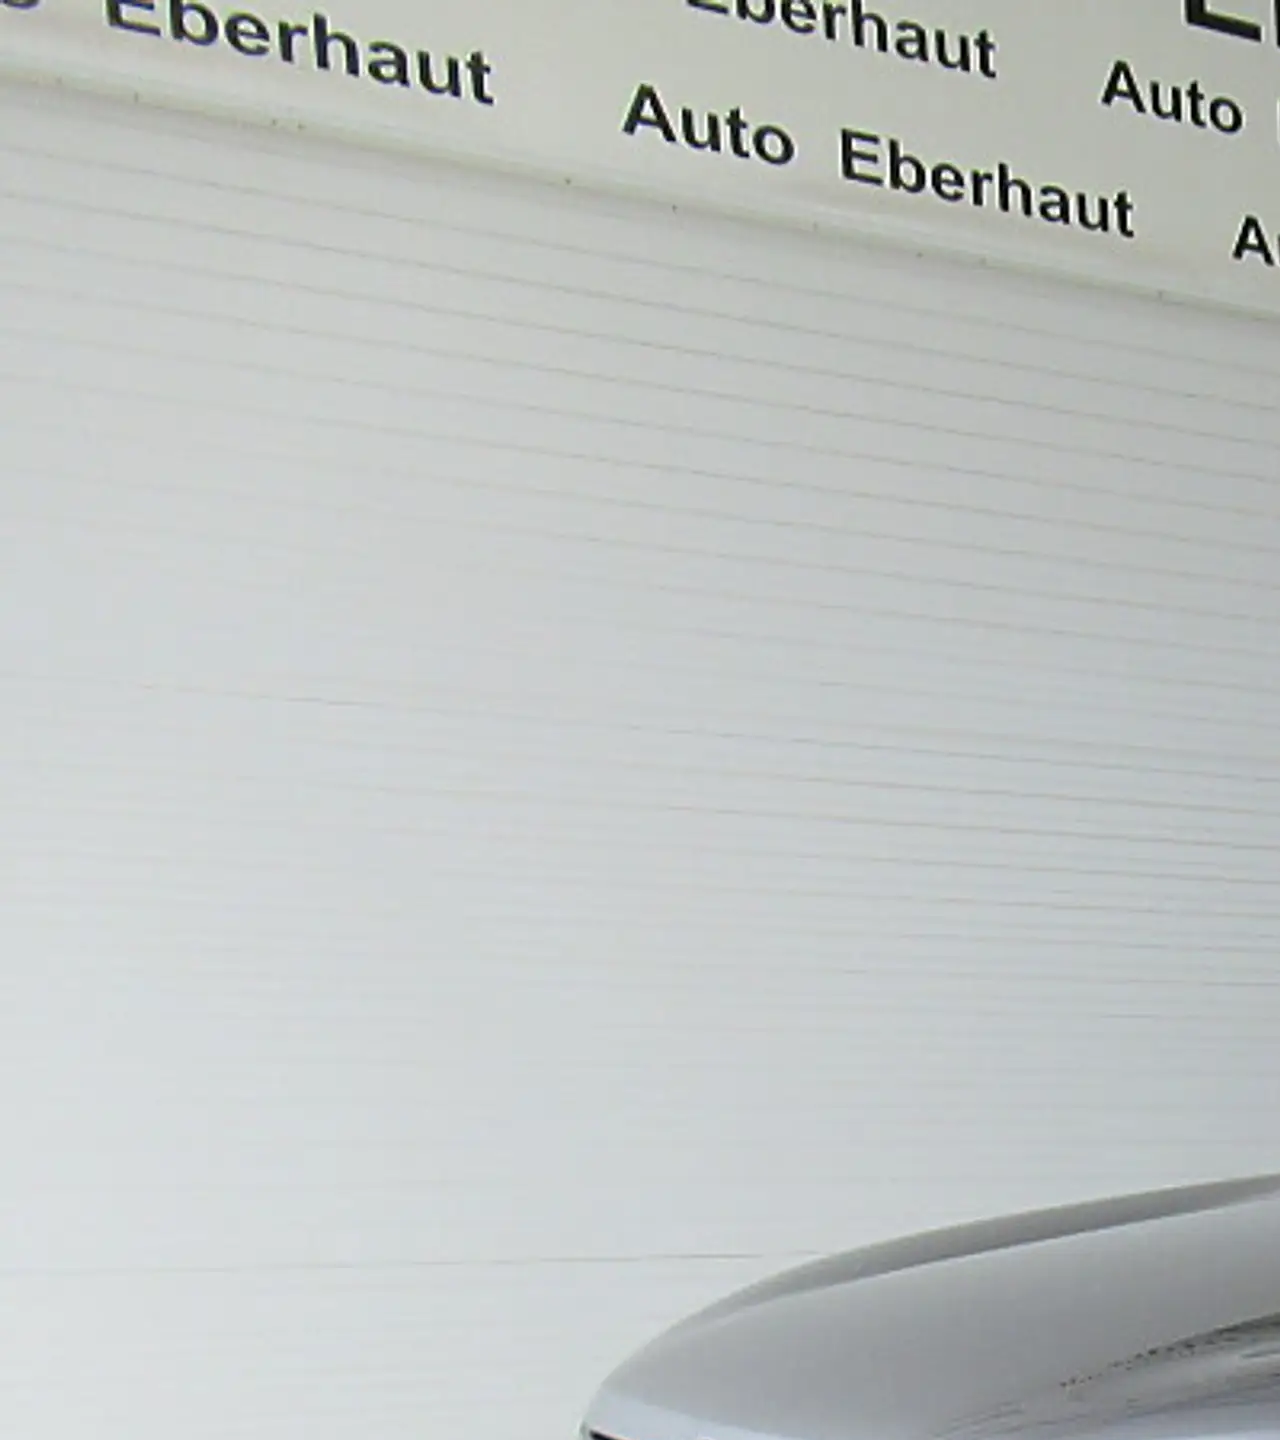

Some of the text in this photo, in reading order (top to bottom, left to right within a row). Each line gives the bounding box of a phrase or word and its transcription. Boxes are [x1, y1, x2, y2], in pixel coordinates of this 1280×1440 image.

[1101, 60, 1244, 134] Auto
[622, 83, 1135, 238] Auto Eberhaut
